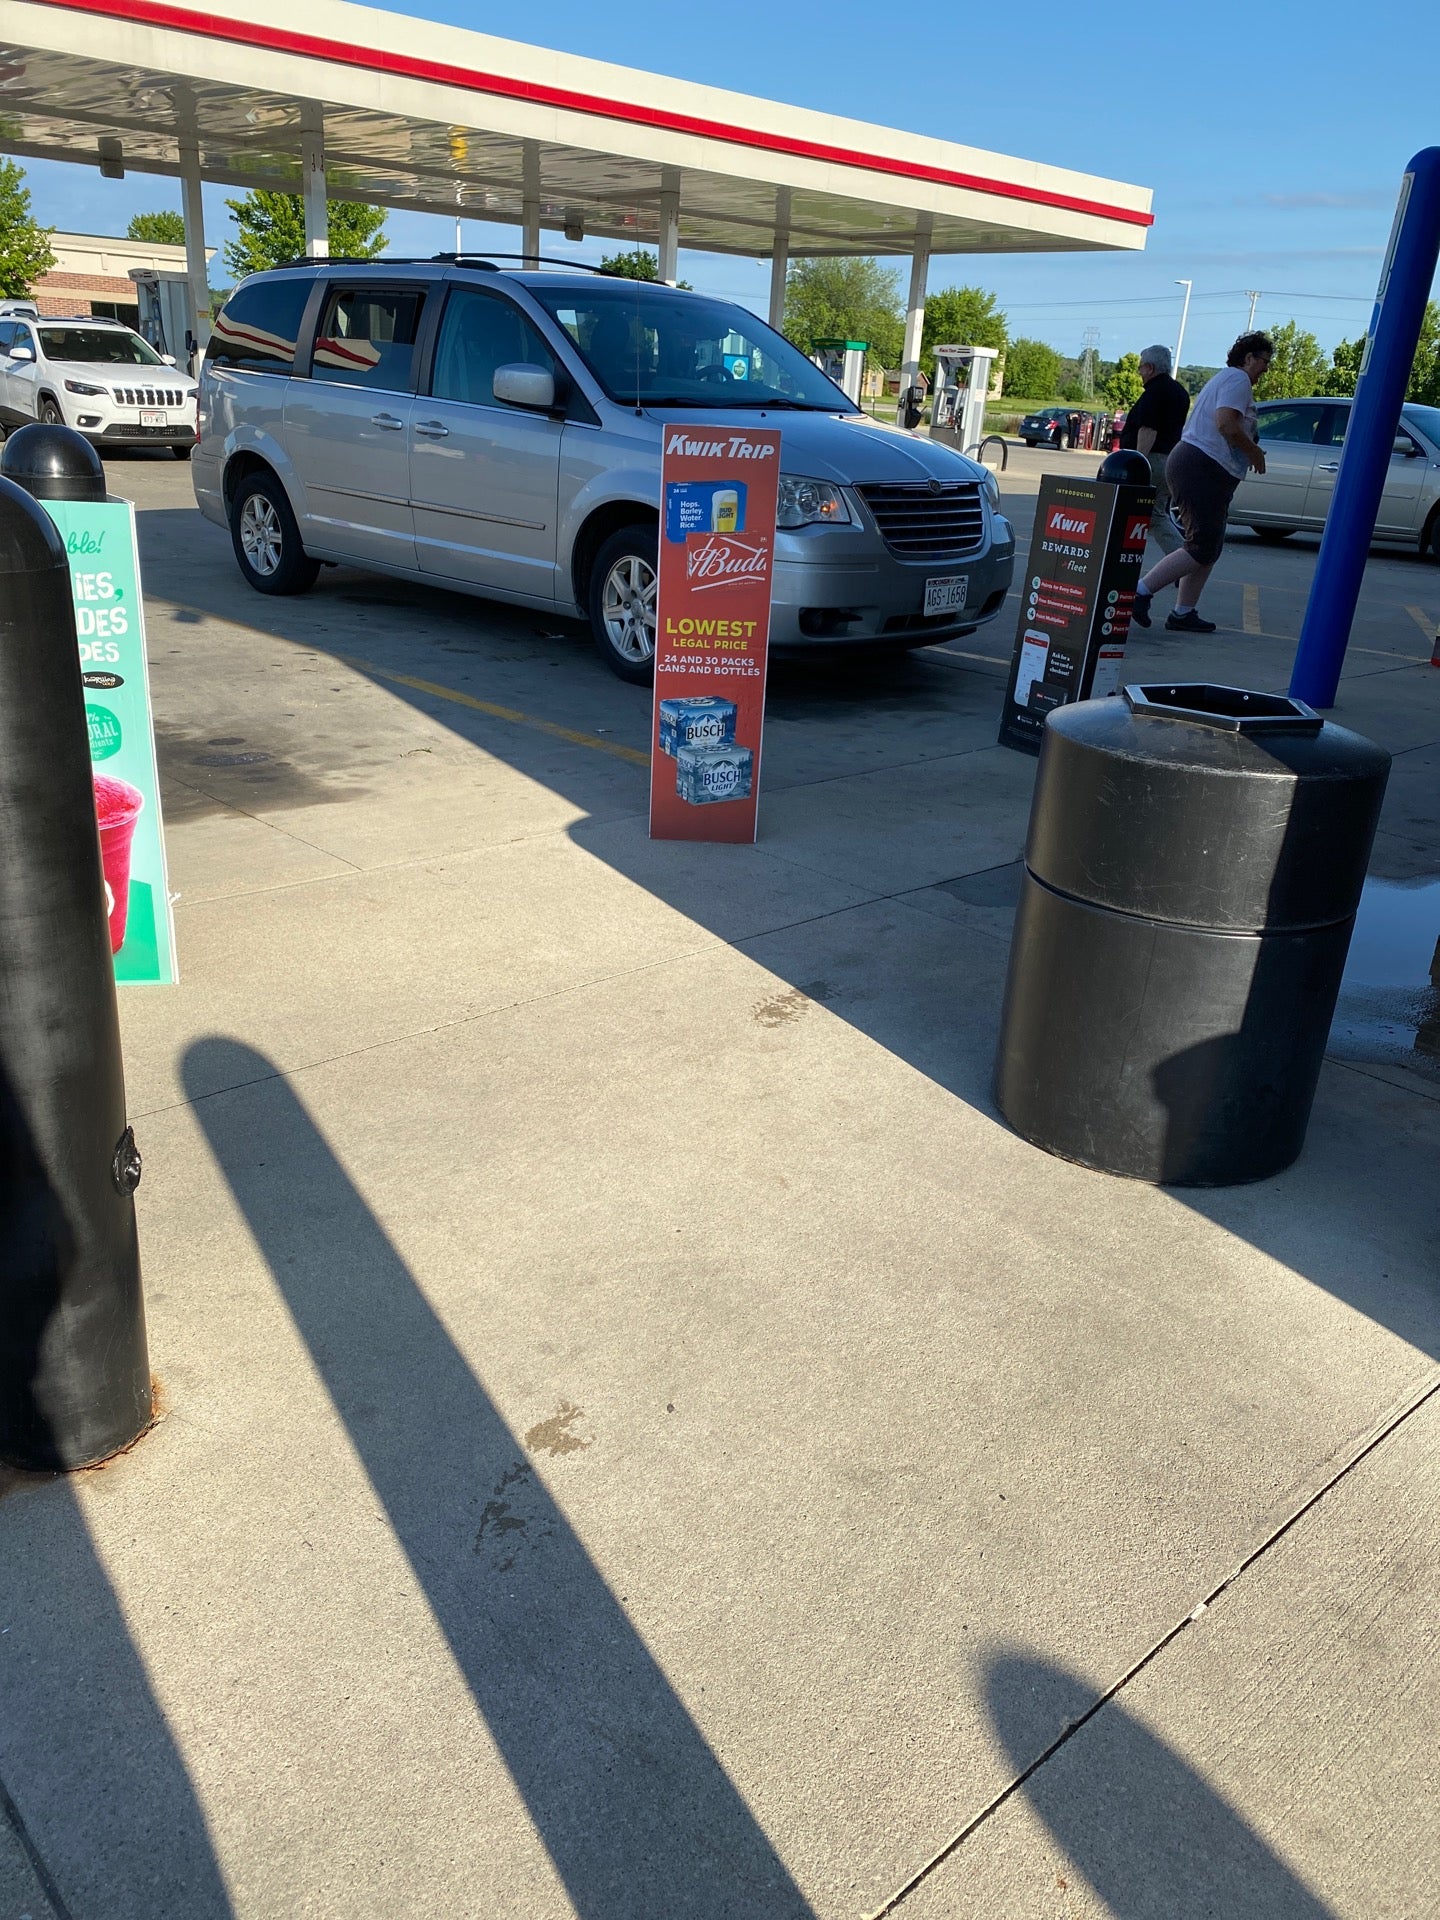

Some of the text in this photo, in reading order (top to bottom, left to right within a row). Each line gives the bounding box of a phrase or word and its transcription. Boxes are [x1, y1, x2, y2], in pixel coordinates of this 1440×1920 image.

[1041, 541, 1090, 559] REWARDS
[1066, 559, 1087, 573] fleet
[77, 606, 128, 637] DES
[666, 617, 757, 637] LOWEST
[673, 638, 748, 650] LEGAL PRICE
[664, 655, 755, 666] 24 AND 30 PACKS
[658, 664, 760, 676] CANS AND BOTTLES
[686, 723, 725, 740] BUSCH
[703, 770, 741, 786] BUSCH
[711, 783, 733, 791] LIGHT
